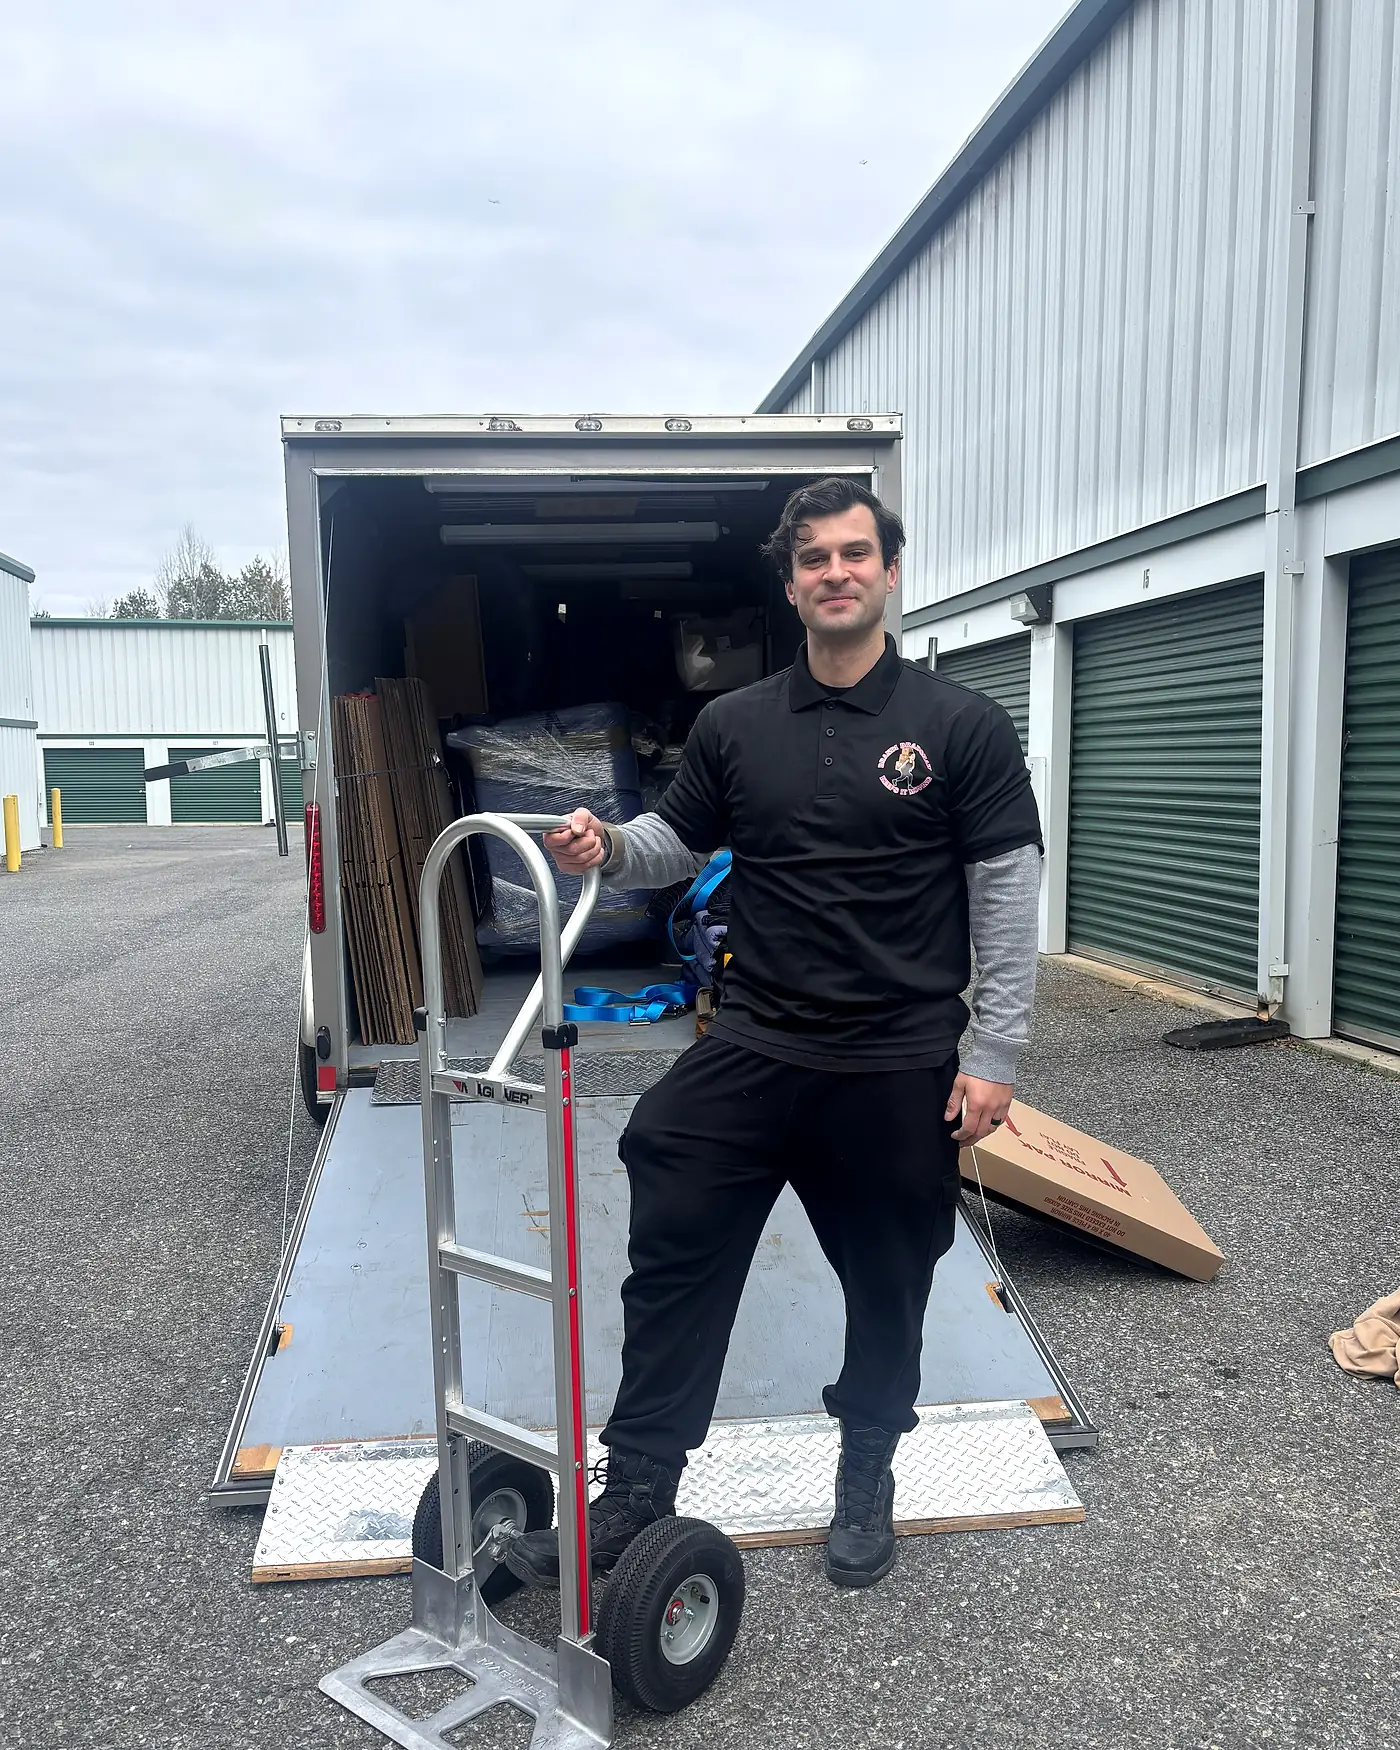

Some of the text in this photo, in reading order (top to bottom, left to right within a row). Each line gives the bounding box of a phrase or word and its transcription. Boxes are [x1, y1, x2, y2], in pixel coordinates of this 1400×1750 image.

[1142, 568, 1150, 589] 15
[1018, 1139, 1132, 1197] MIRROR PAK
[1057, 1195, 1078, 1207] CARTON
[1051, 1207, 1072, 1220] MIRROR
[1061, 1204, 1073, 1213] SIZE
[1073, 1209, 1085, 1218] THIS
[1079, 1204, 1091, 1213] THIS
[1072, 1216, 1087, 1227] PIECE
[1086, 1214, 1105, 1228] EXCEED
[1092, 1210, 1113, 1224] PACKING
[1105, 1223, 1117, 1233] NOT
